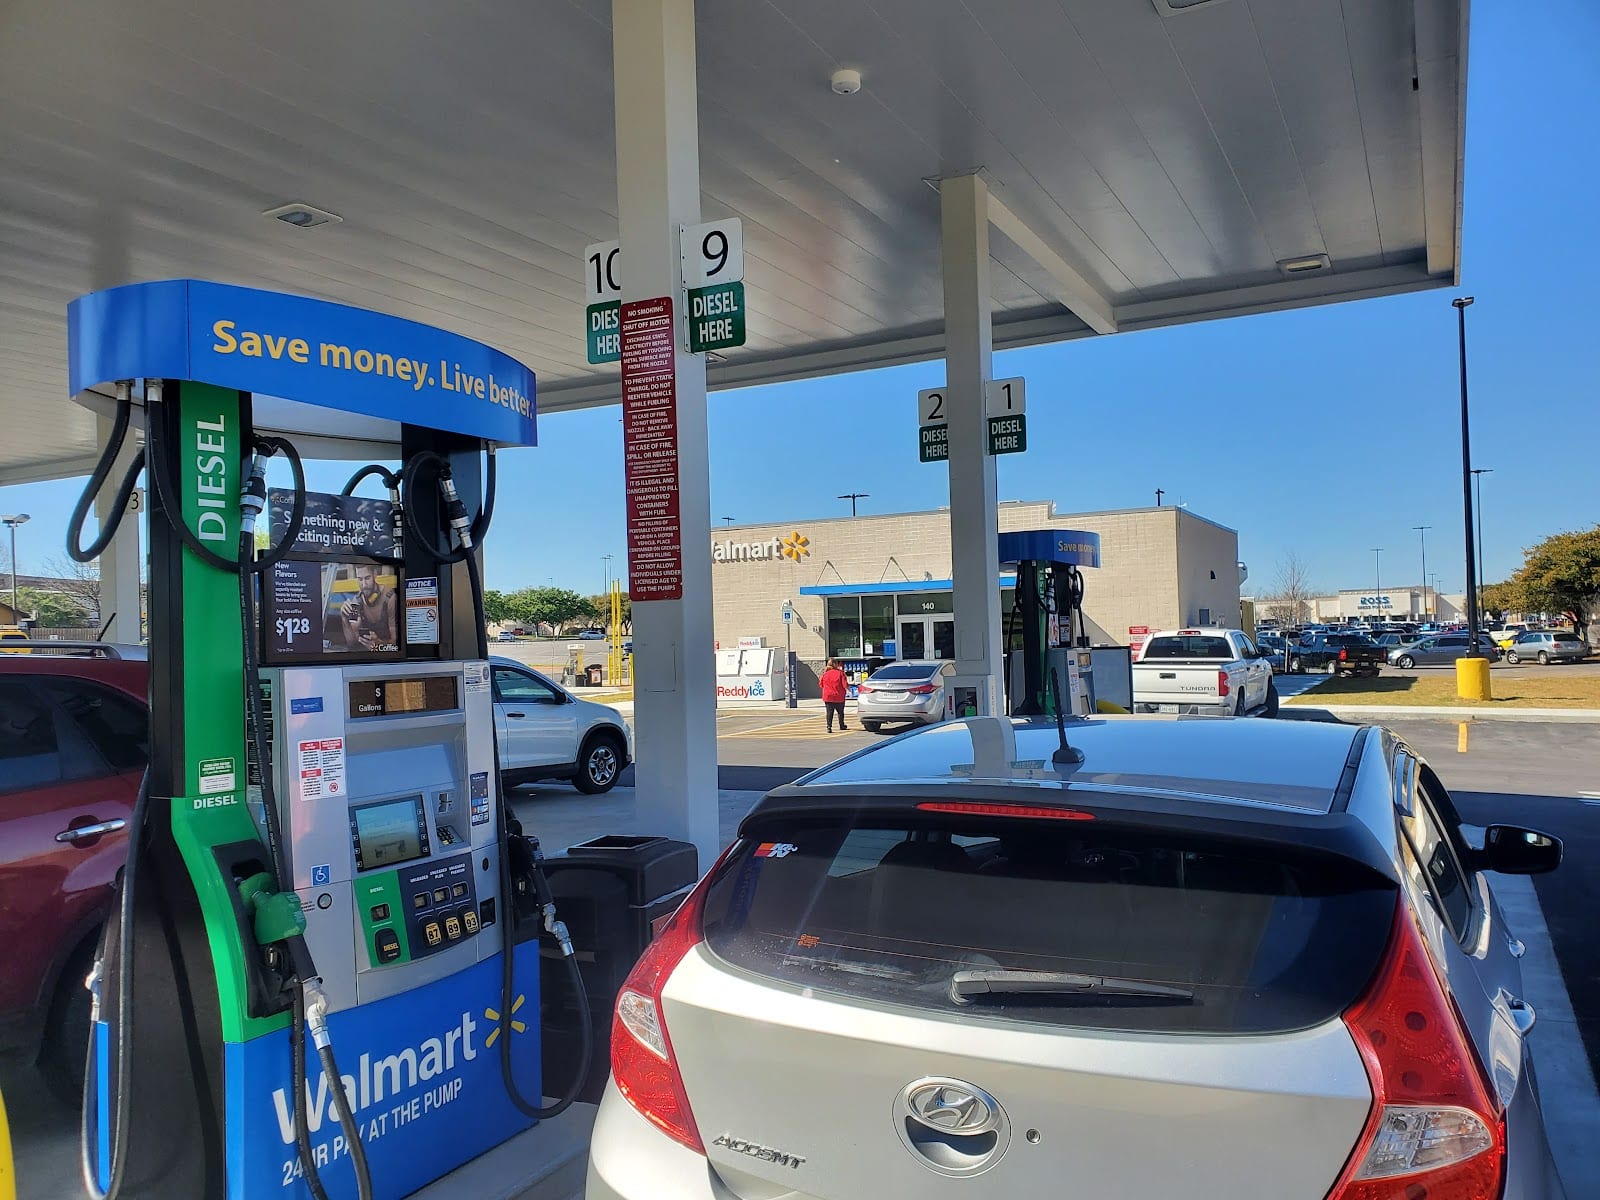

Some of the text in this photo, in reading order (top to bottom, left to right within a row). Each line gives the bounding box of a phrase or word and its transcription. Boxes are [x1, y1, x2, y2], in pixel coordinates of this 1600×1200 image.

[702, 231, 729, 277] 9
[637, 306, 664, 316] SMOKING
[693, 291, 738, 318] DIESEL
[591, 309, 619, 332] DIES
[623, 323, 637, 331] SHUT
[650, 318, 670, 327] MOTOR
[699, 319, 733, 343] HERE
[596, 334, 621, 356] HER
[213, 320, 533, 420] Save money. Live better.
[632, 376, 656, 384] PREVENT
[628, 390, 672, 401] REENTER VEHICLE
[647, 398, 670, 406] FUELING
[1001, 384, 1012, 410] 1
[927, 394, 944, 420] 2
[991, 420, 1022, 435] DIESEL
[922, 430, 948, 443] DIESE
[994, 436, 1018, 450] HERE
[652, 450, 677, 458] RELEASE
[925, 444, 948, 458] HERE
[196, 415, 226, 542] DIESEL
[627, 487, 659, 495] DANGEROUS
[634, 494, 671, 502] UNAPPROVED
[636, 501, 669, 509] CONTAINERS
[283, 510, 382, 532] Smething new &
[295, 530, 365, 547] citing inside
[711, 537, 780, 561] almart
[1058, 541, 1077, 552] Save
[275, 570, 297, 578] Flavors
[408, 580, 432, 588] NOTICE
[921, 602, 935, 610] 140
[1360, 597, 1390, 605] ROSS
[378, 644, 399, 652] Coffee
[717, 685, 765, 699] ReddyIce
[358, 704, 382, 712] Gallons
[193, 795, 238, 810] DIESEL
[448, 924, 459, 934] 89
[466, 918, 477, 928] 93
[428, 929, 439, 940] 87
[383, 943, 399, 952] DIESEL
[272, 1012, 477, 1146] Walmart
[368, 1113, 389, 1143] AT
[391, 1098, 421, 1129] THE
[424, 1078, 463, 1113] PUMP
[712, 1136, 806, 1169] ACCENT
